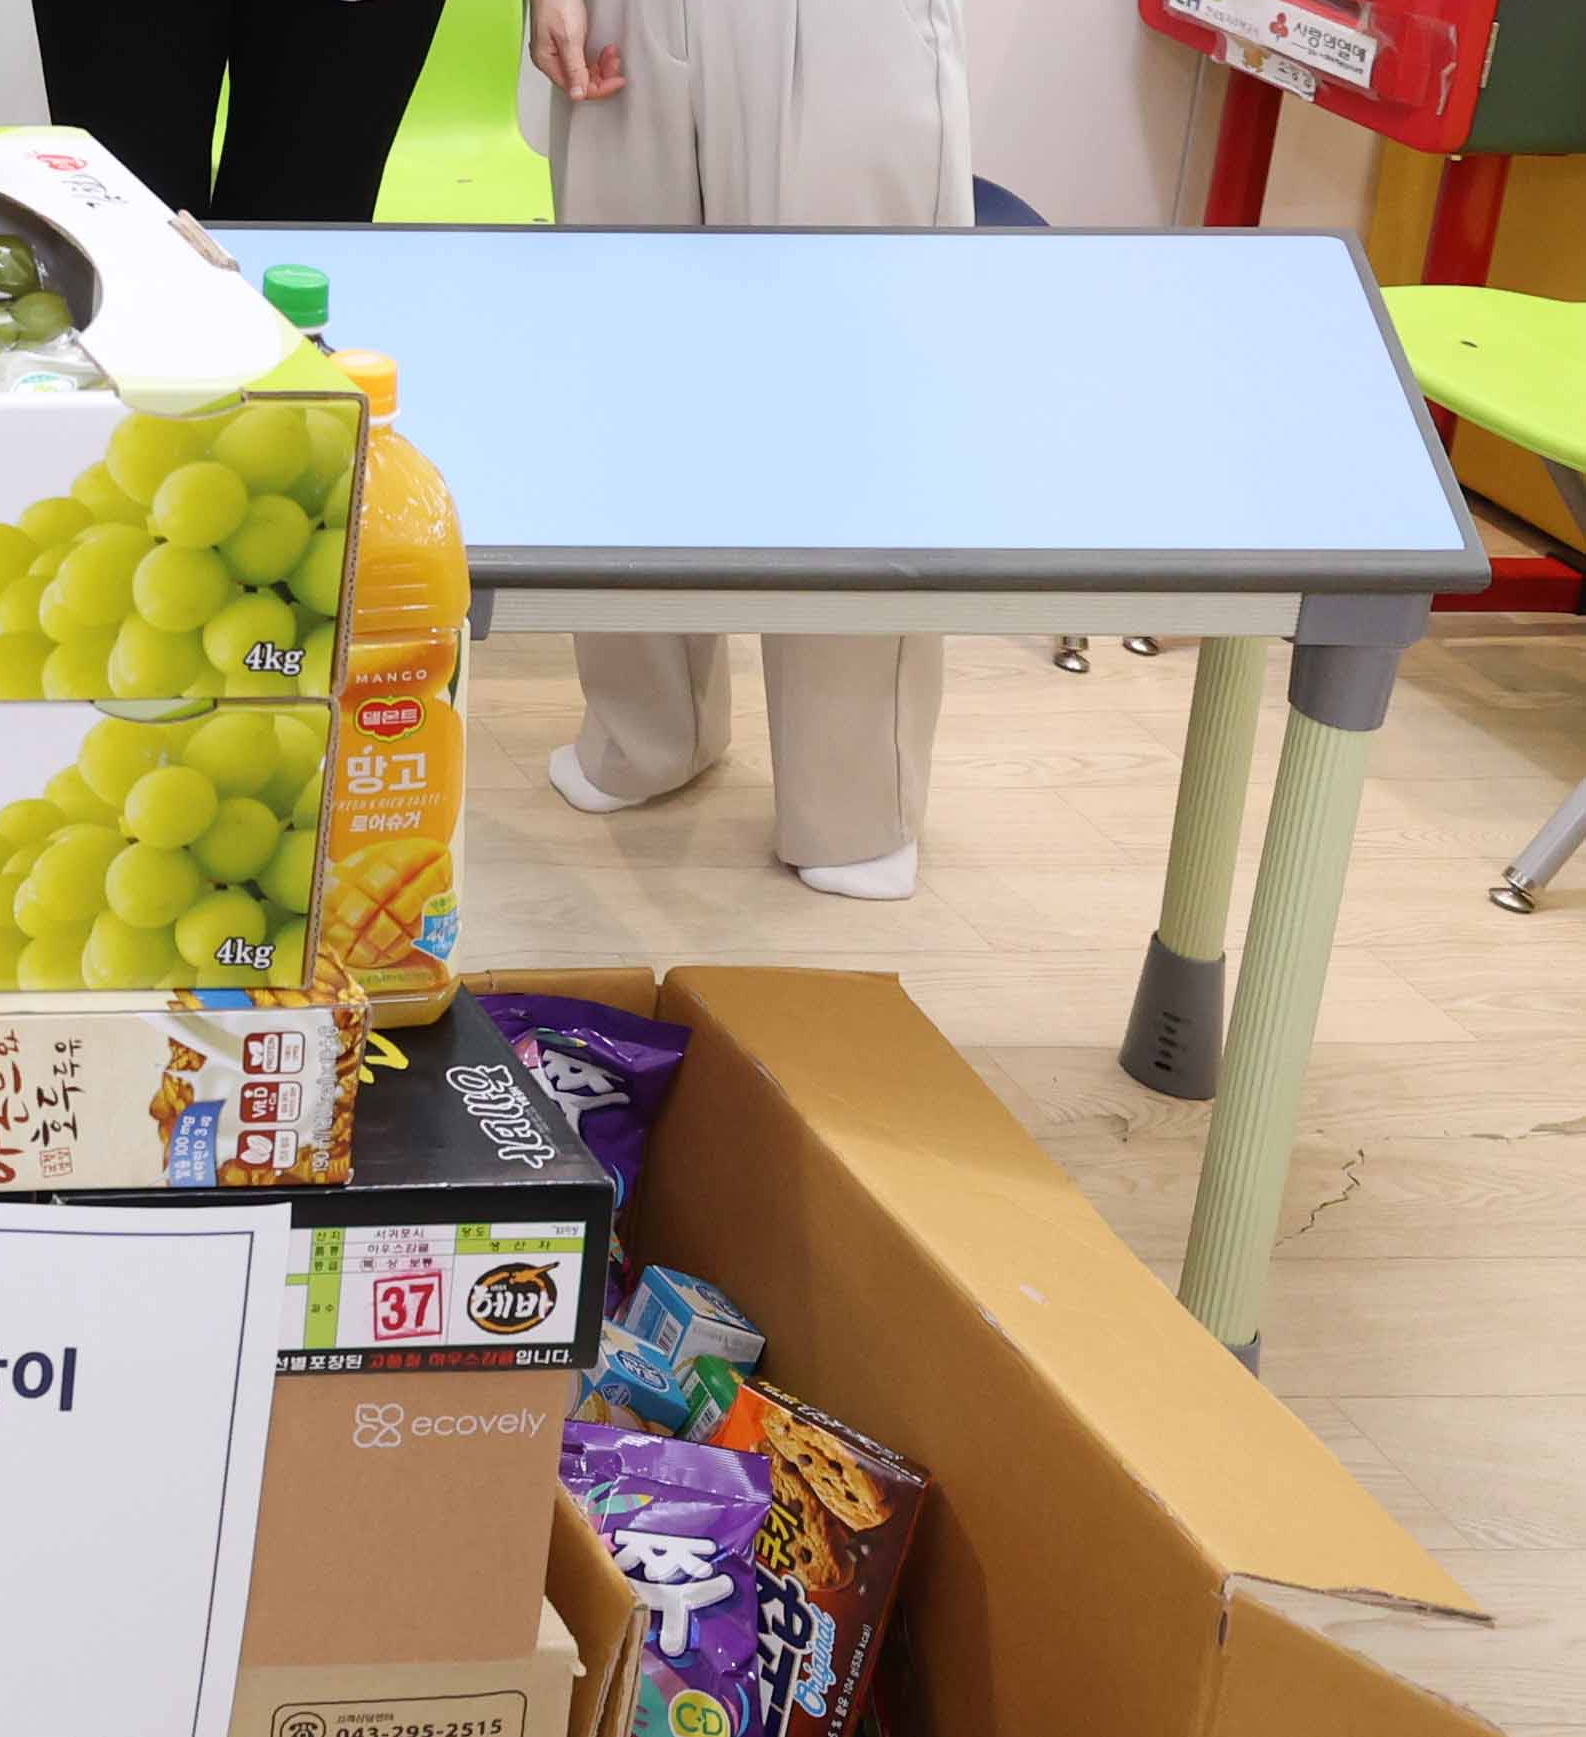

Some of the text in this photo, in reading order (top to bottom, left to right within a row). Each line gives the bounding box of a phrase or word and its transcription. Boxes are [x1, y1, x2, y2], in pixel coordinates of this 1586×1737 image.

[245, 640, 303, 677] 4kg
[356, 669, 427, 684] MANGO
[347, 745, 428, 795] 망고
[349, 811, 422, 833] 로어슈거
[215, 937, 275, 970] 4kg
[379, 1282, 435, 1331] 37
[411, 1407, 547, 1439] ecovely
[753, 1502, 799, 1571] 쿠키
[794, 1601, 838, 1719] Original
